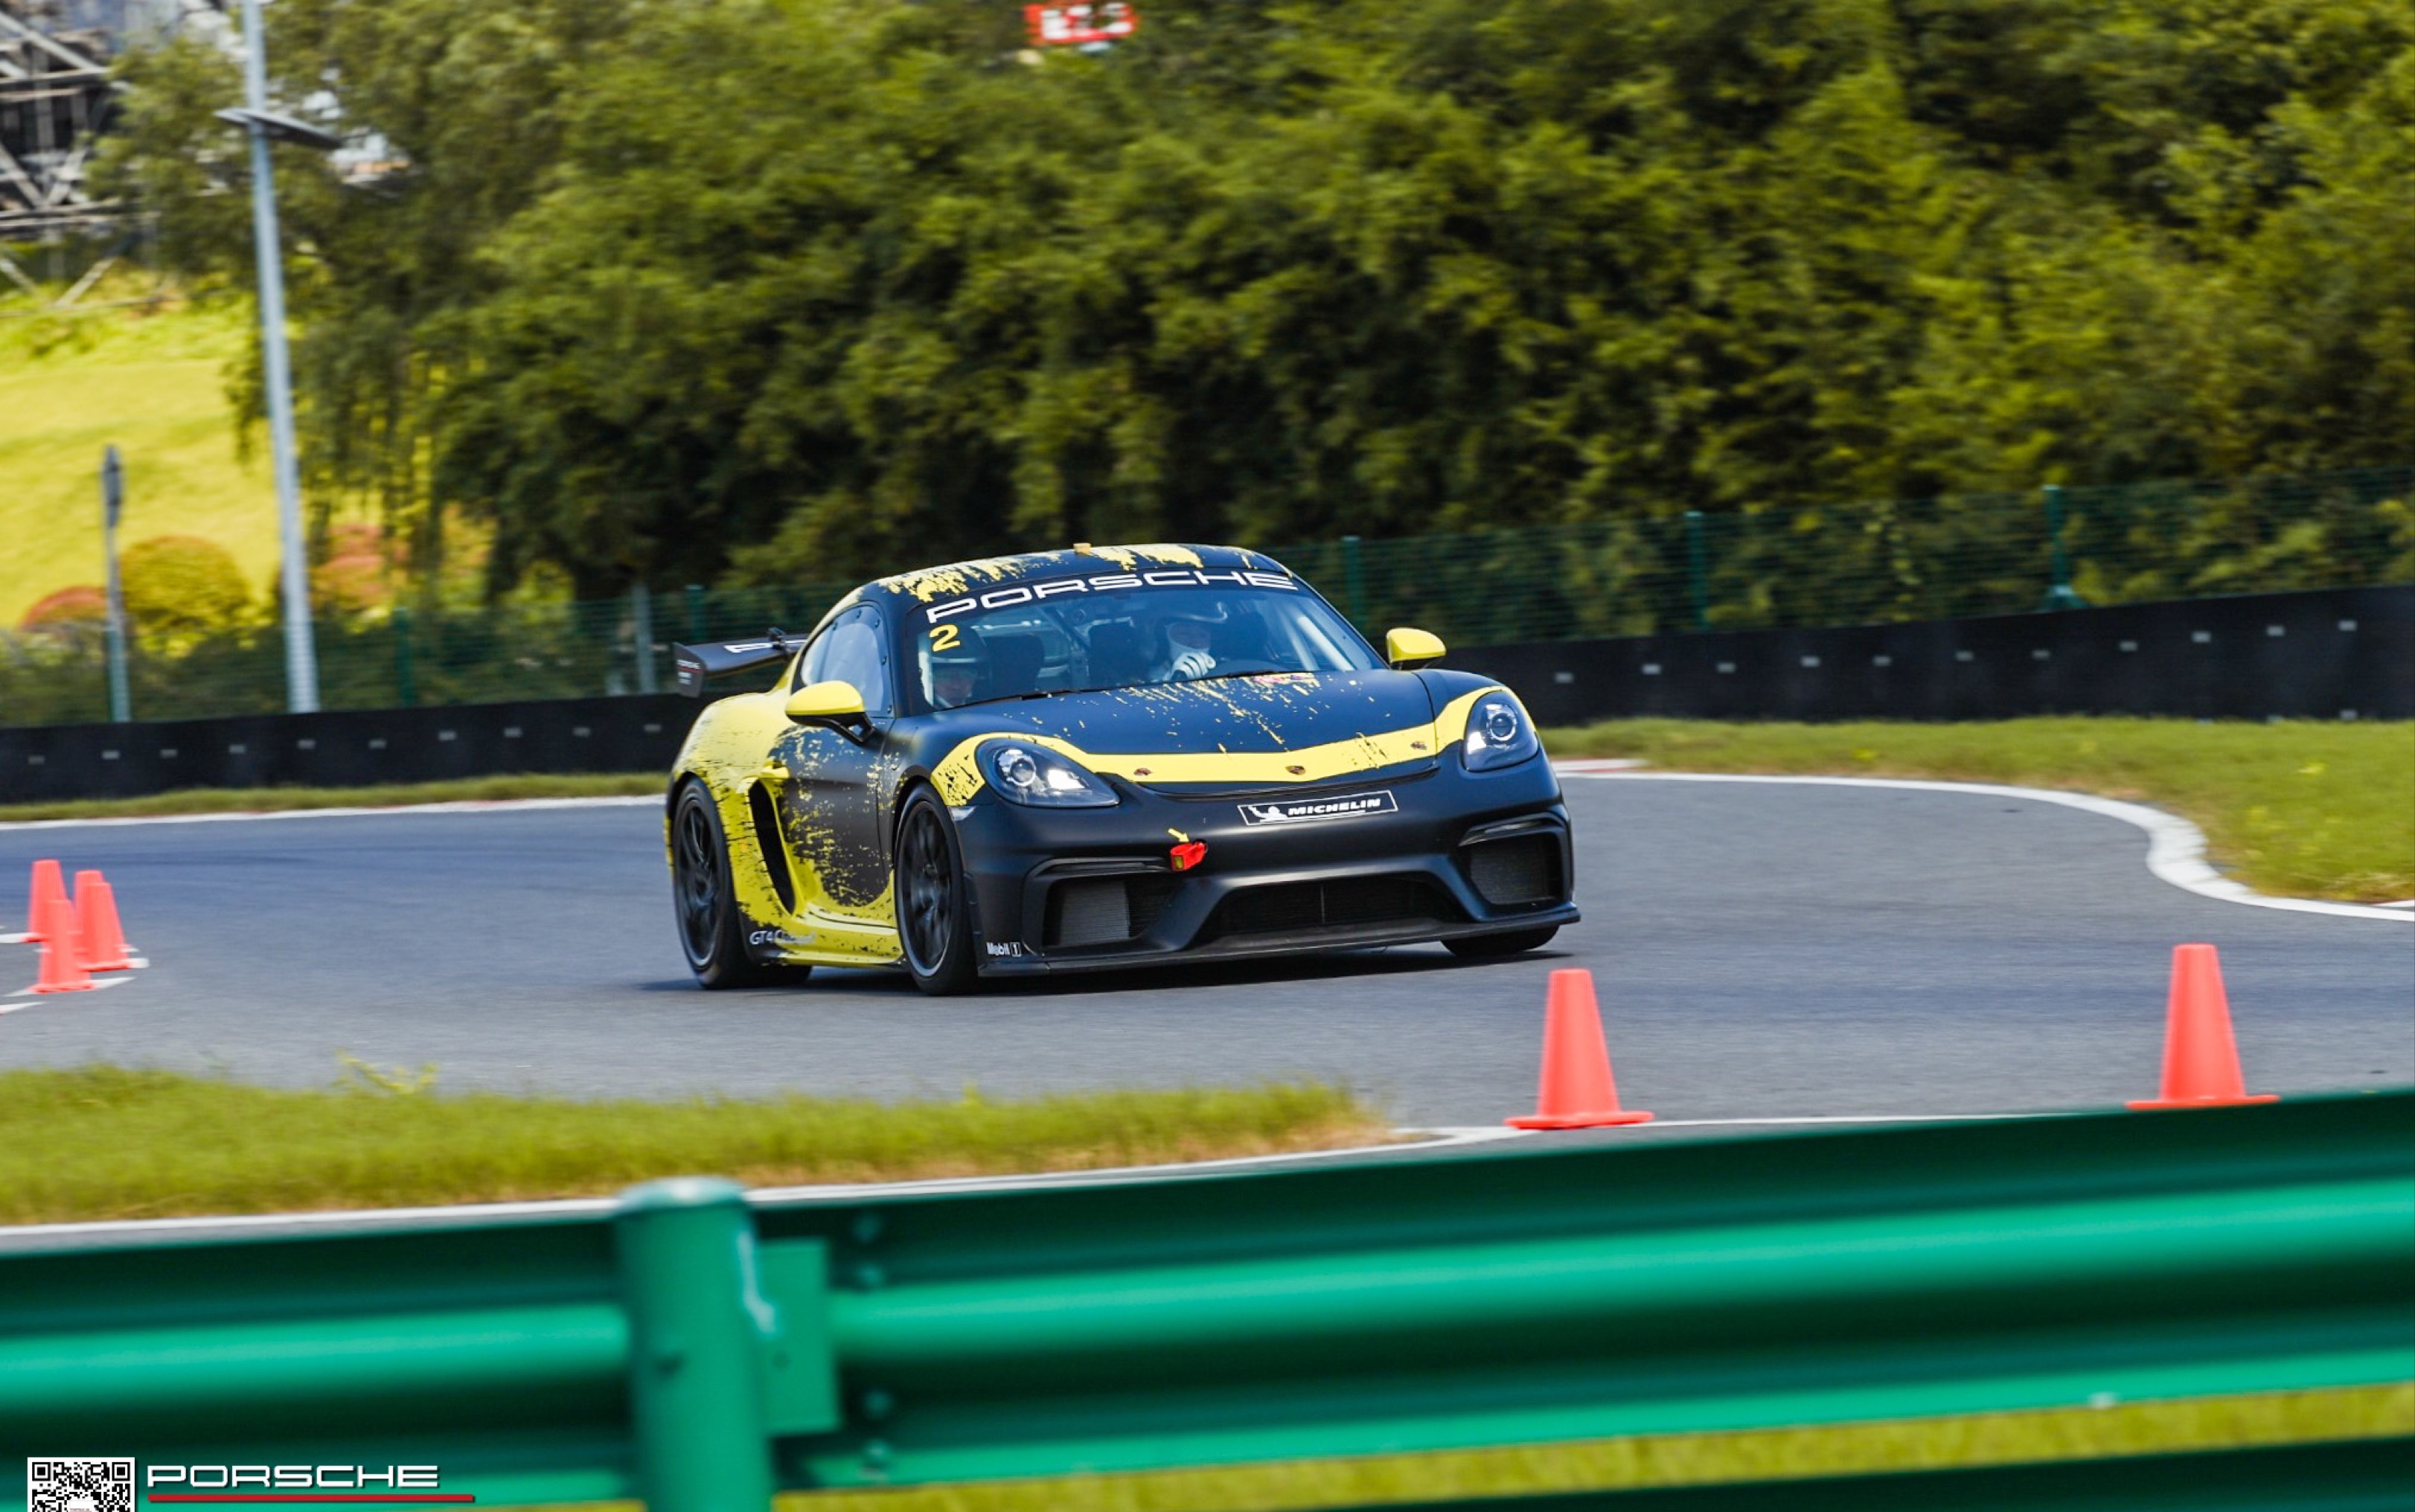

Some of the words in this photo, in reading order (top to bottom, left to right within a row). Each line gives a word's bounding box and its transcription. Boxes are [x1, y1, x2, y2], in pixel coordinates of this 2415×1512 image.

[926, 571, 1298, 624] PORSCHE
[929, 624, 961, 652] 2
[1288, 798, 1381, 816] MICHELIN
[986, 942, 1010, 956] Mobil
